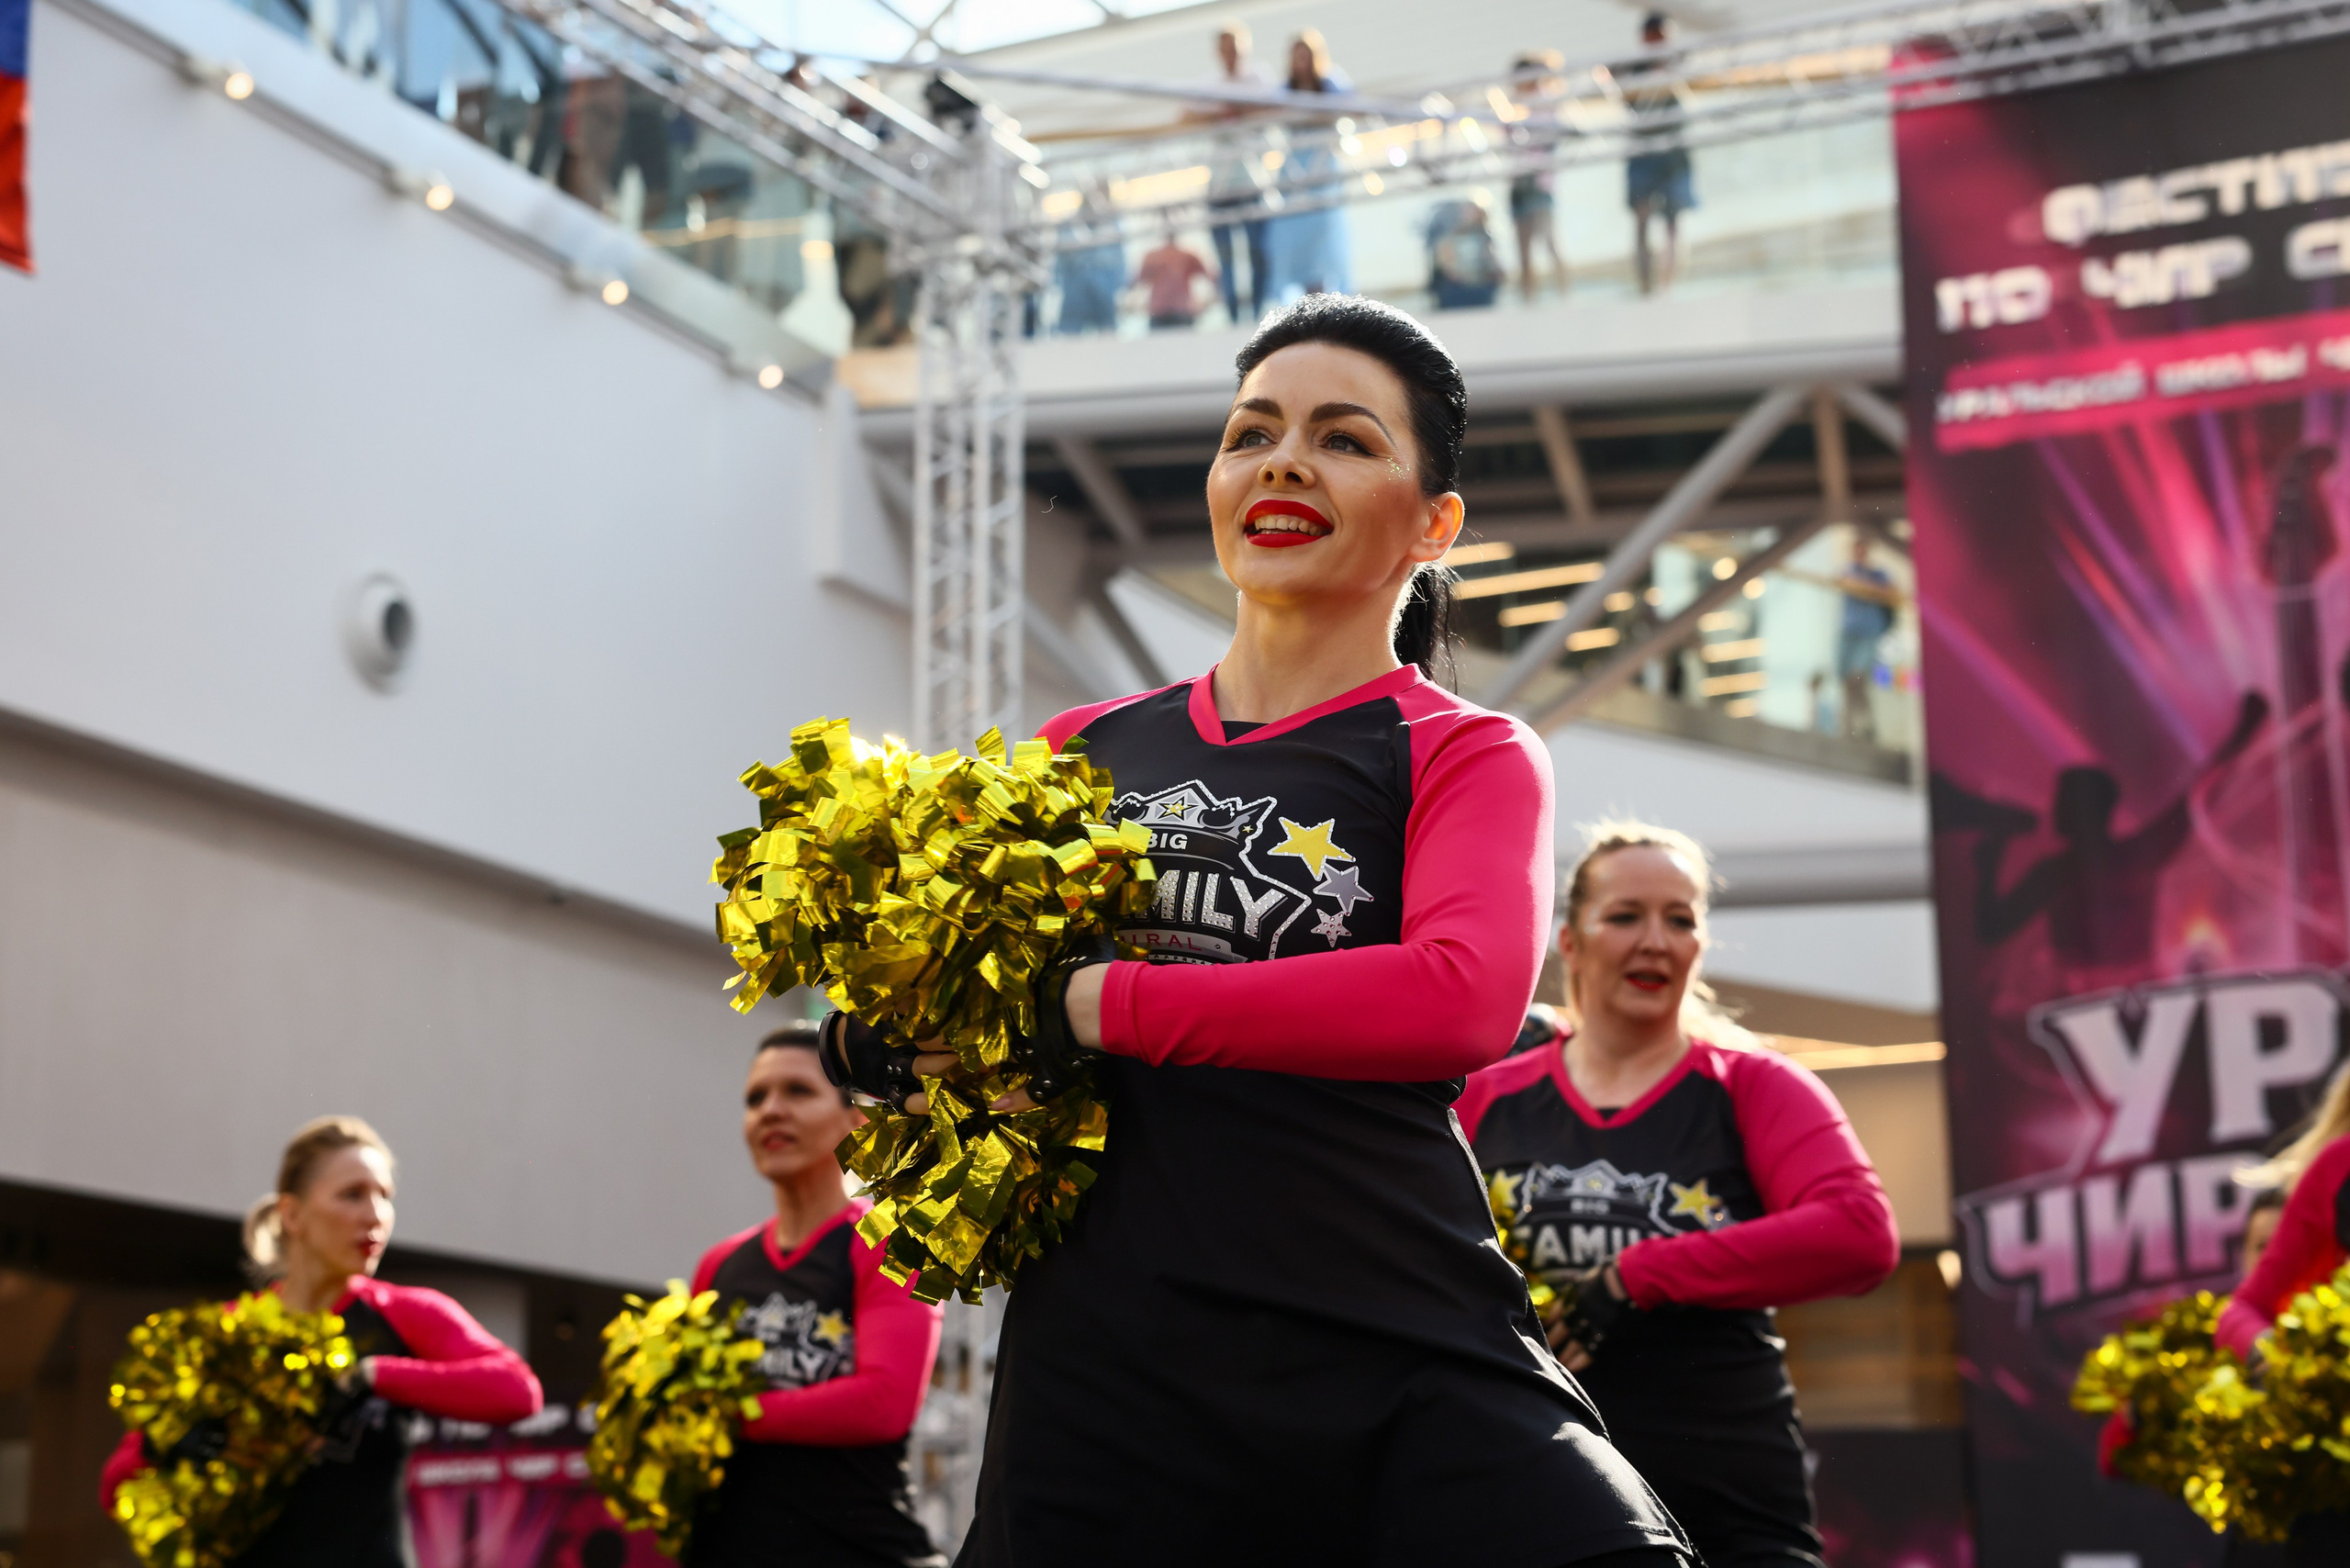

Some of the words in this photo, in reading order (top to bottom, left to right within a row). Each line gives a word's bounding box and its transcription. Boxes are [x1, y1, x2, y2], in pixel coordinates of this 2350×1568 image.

[1935, 265, 2052, 332] ПО
[2080, 236, 2253, 308] ЧИР
[2286, 218, 2350, 281] С
[1147, 832, 1189, 851] BIG
[1124, 868, 1286, 939] MILY
[1986, 1156, 2260, 1309] ЧИР
